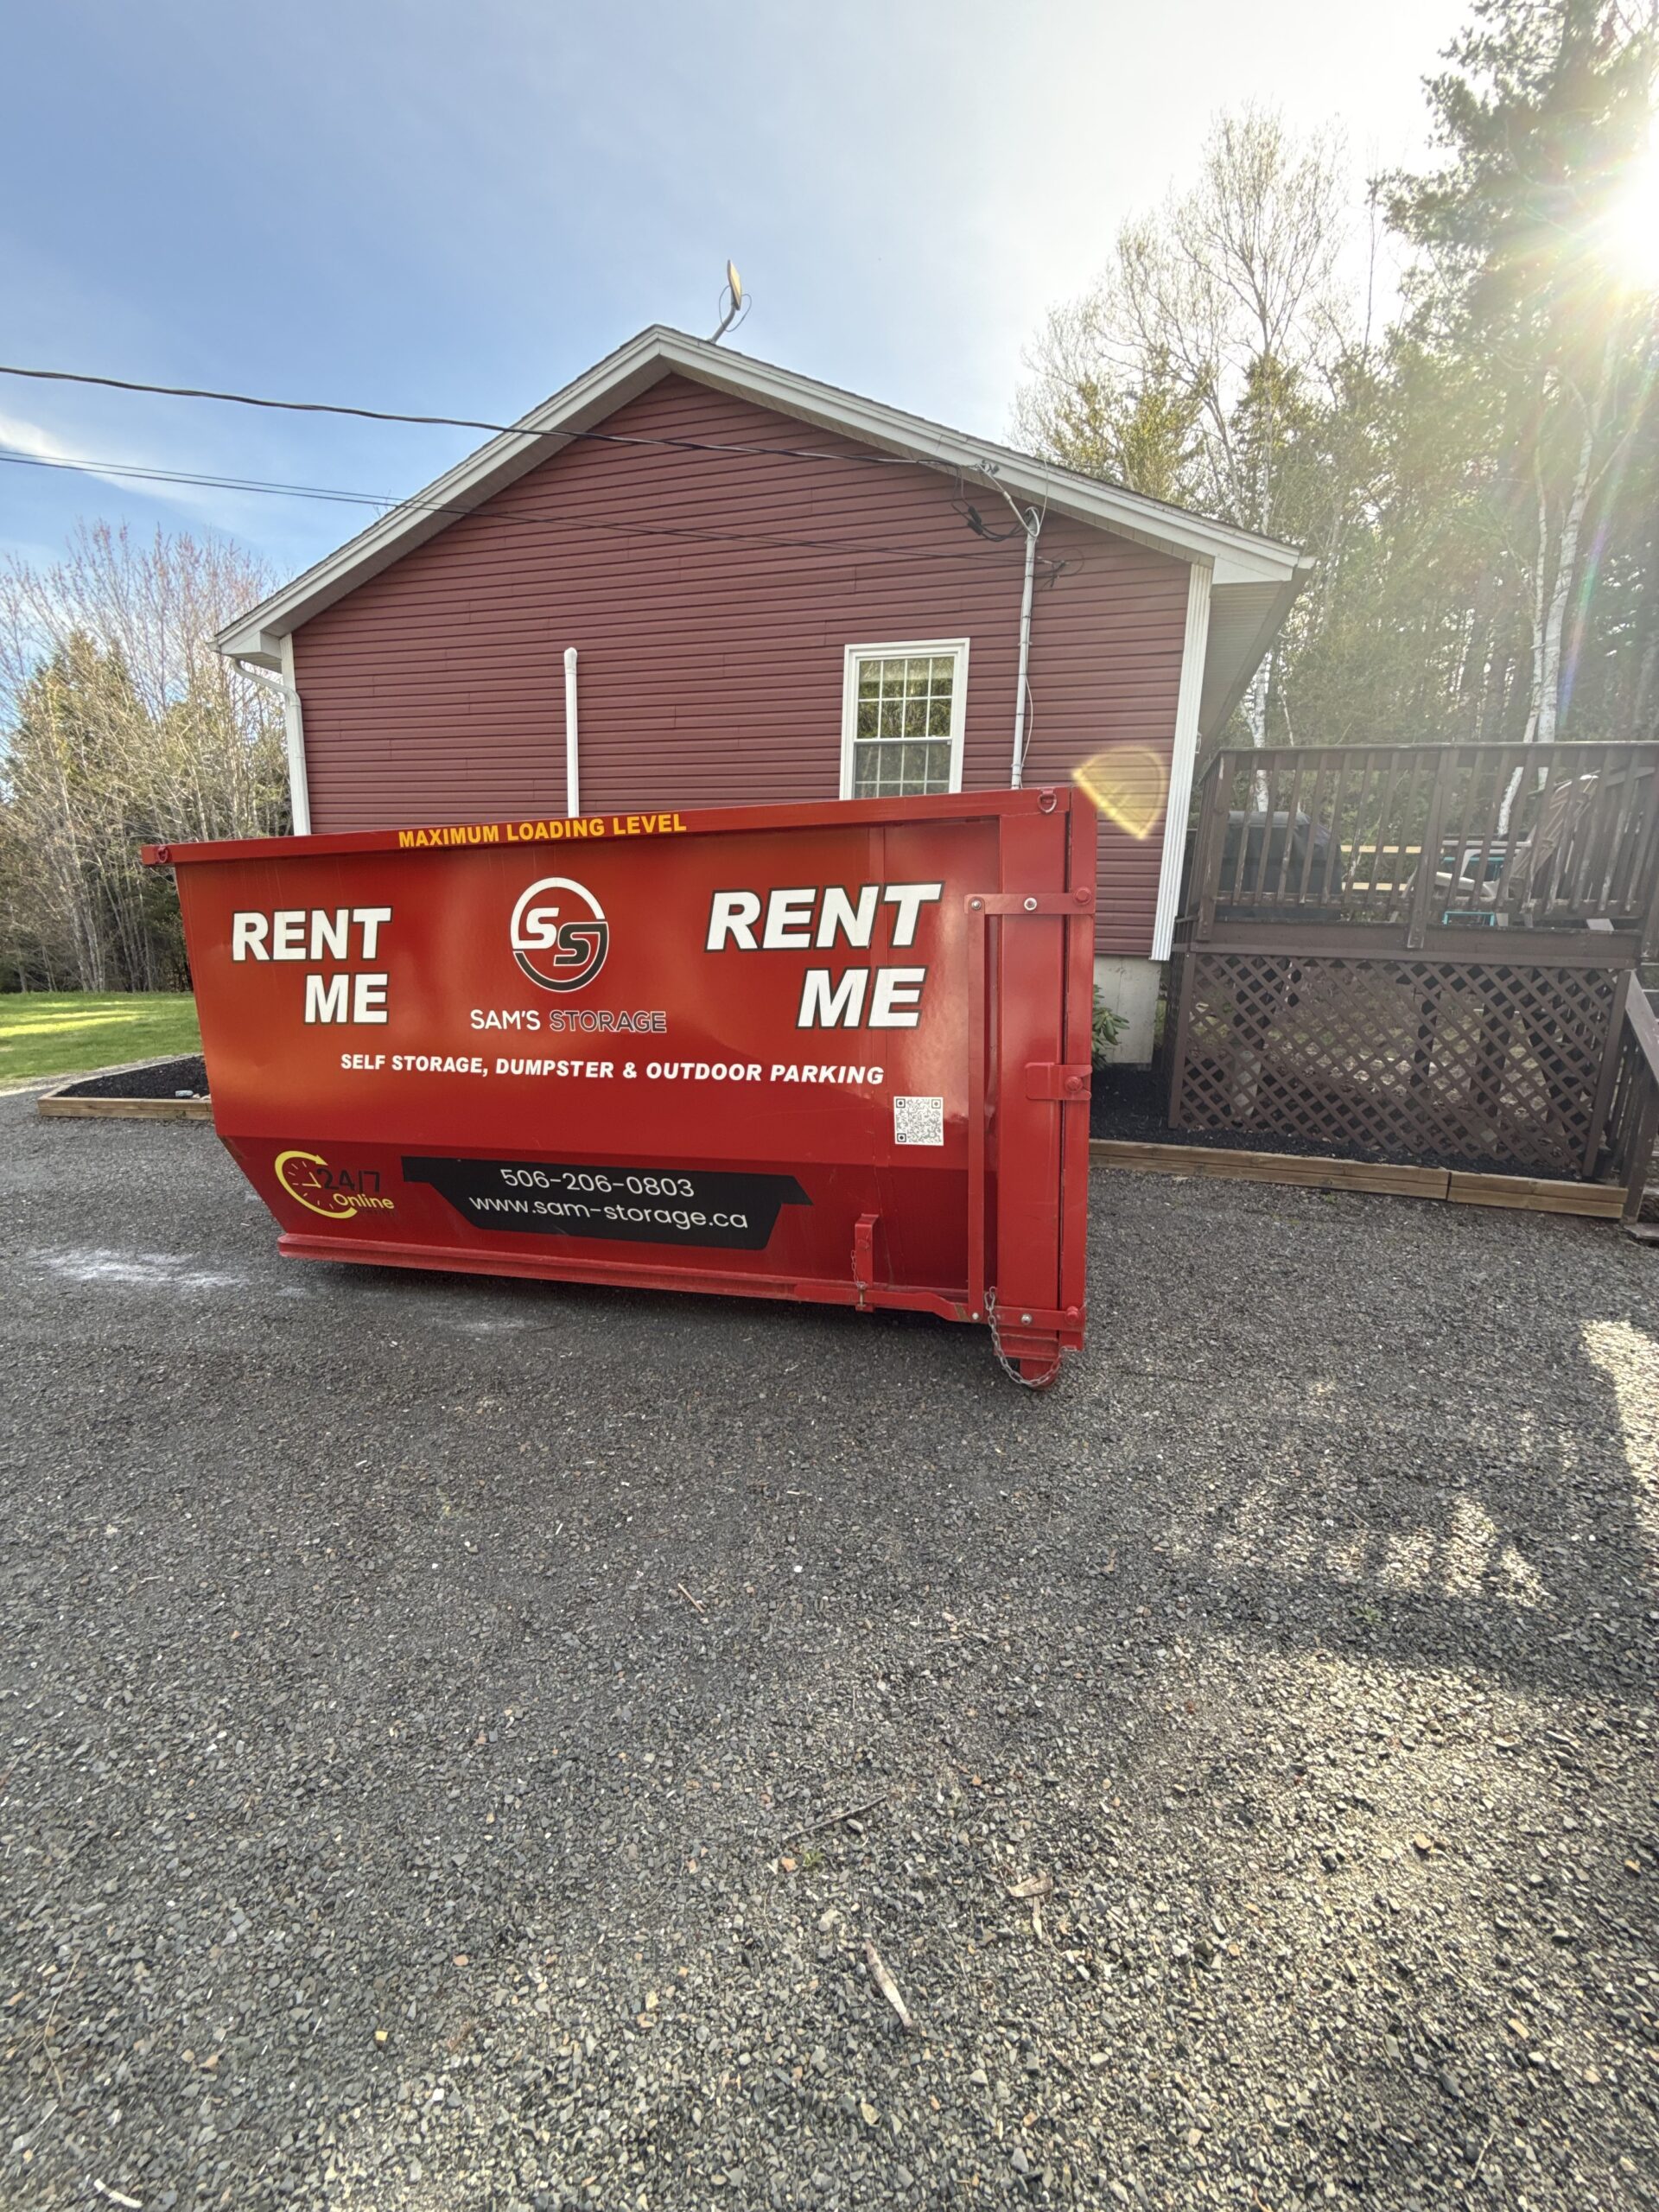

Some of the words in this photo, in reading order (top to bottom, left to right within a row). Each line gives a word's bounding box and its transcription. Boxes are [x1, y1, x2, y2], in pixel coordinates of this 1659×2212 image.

[398, 825, 499, 848] MAXIMUM
[507, 819, 605, 841] LOADING
[613, 814, 687, 835] LEVEL
[232, 906, 392, 961] RENT
[703, 883, 944, 952] RENT
[304, 972, 388, 1024] ME
[797, 965, 927, 1030] ME
[471, 1009, 541, 1030] SAM'S
[550, 1010, 667, 1033] STORAGE
[340, 1053, 385, 1070] SELF
[391, 1055, 488, 1077] STORAGE,
[495, 1058, 614, 1078] DUMPSTER
[622, 1061, 638, 1078] &
[646, 1062, 762, 1081] OUTDOOR
[770, 1064, 885, 1085] PARKING
[500, 1168, 695, 1198] 506-206-0803
[332, 1192, 395, 1210] Online
[469, 1197, 748, 1230] www.sam-storage.ca
